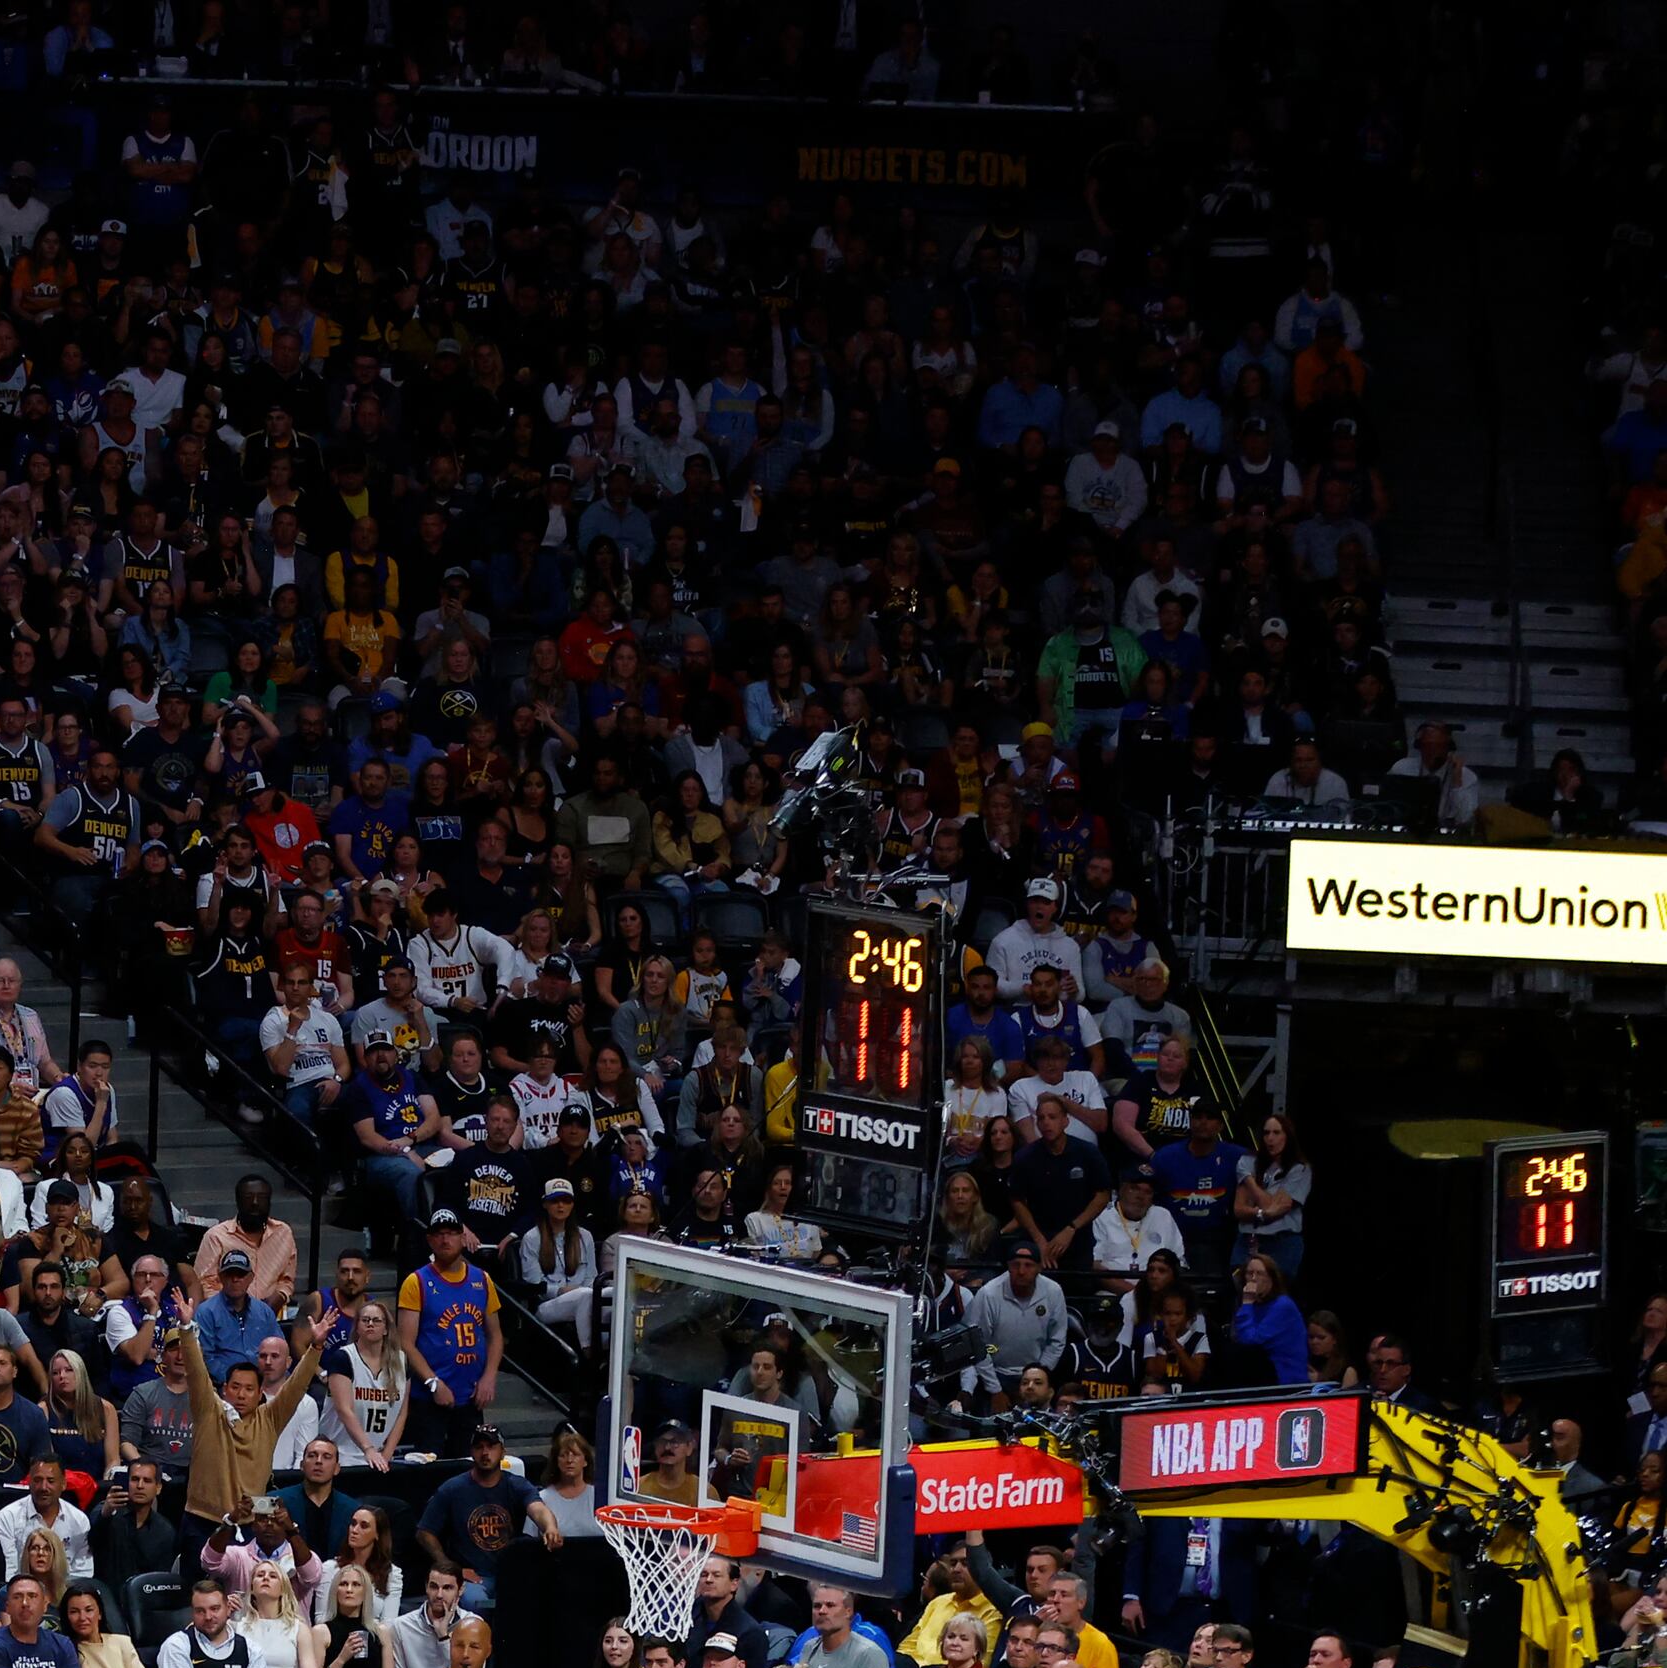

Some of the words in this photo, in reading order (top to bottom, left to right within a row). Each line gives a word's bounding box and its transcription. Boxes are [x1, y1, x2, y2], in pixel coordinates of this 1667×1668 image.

[424, 132, 537, 172] ORDON
[797, 146, 1027, 189] NUGGETS.COM
[1100, 647, 1114, 663] 15
[9, 782, 31, 801] 15
[83, 818, 127, 838] DENVER
[1307, 877, 1648, 931] WesternUnion
[316, 960, 332, 978] 15
[431, 962, 475, 980] NUGGETS
[848, 929, 924, 994] 2:46
[245, 976, 252, 999] 1
[315, 1028, 331, 1044] 15
[836, 1111, 922, 1151] TISSOT
[1164, 1106, 1191, 1131] NBA
[474, 1164, 514, 1182] DENVER
[1524, 1152, 1589, 1198] 2:46
[1528, 1270, 1600, 1296] TISSOT
[438, 1304, 464, 1331] MILE
[464, 1302, 485, 1326] HIGH
[455, 1323, 476, 1348] 15
[455, 1352, 478, 1367] CITY
[367, 1408, 388, 1433] 15
[1151, 1422, 1207, 1477] NBA
[1211, 1417, 1265, 1472] APP
[919, 1474, 1064, 1513] StateFarm
